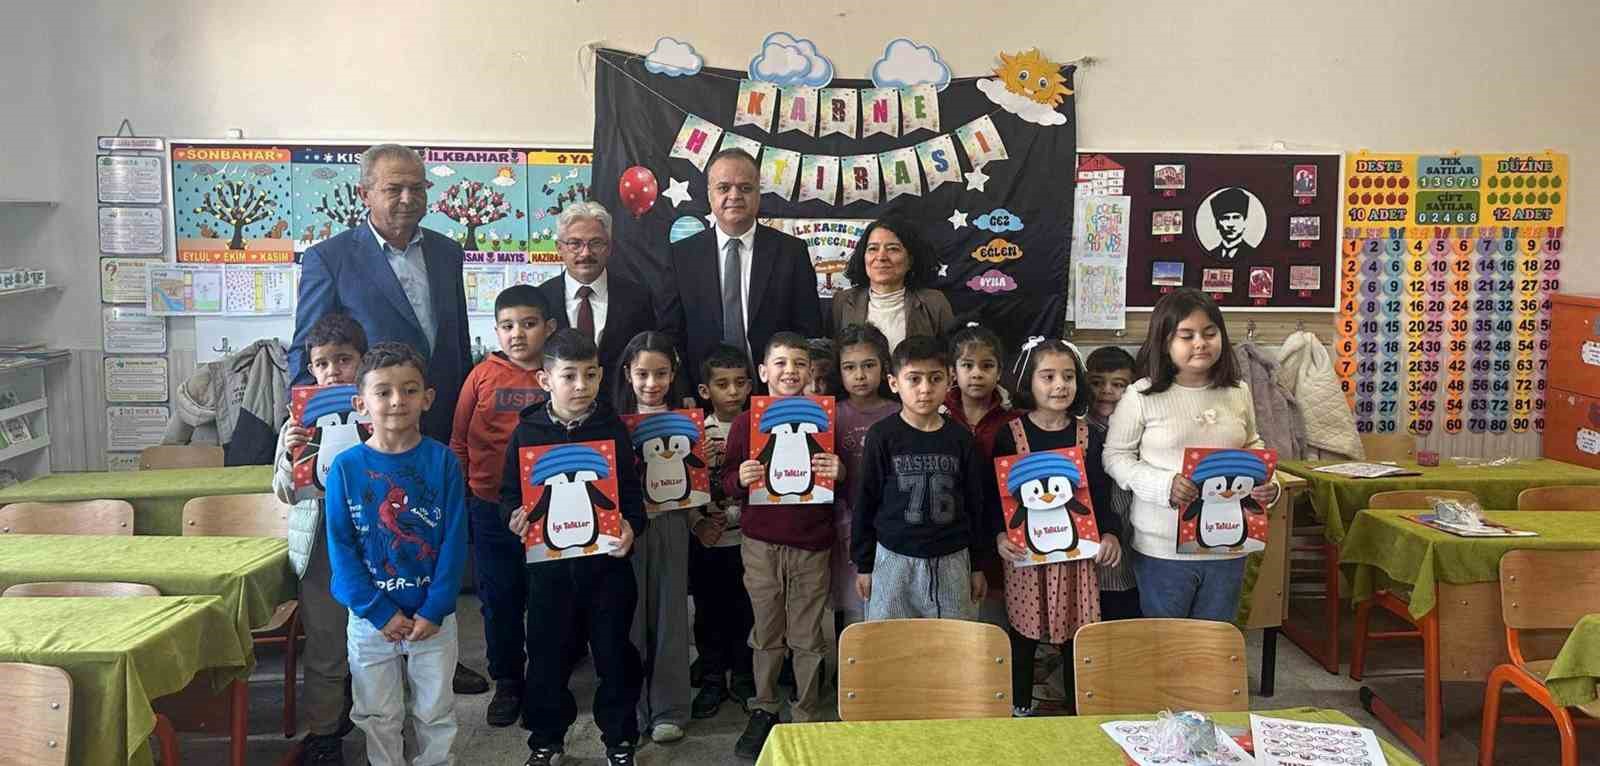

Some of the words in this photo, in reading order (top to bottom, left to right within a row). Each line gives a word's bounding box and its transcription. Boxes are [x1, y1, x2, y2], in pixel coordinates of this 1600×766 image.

[747, 91, 927, 123] KARNE
[186, 150, 277, 161] SONBAHAR
[428, 150, 509, 163] İLKBAHAR
[571, 153, 593, 165] YA
[685, 127, 991, 190] HTIRASI
[1357, 160, 1402, 173] DESTE
[1440, 158, 1461, 166] TEK
[1498, 156, 1553, 173] DÜZİNE
[1426, 166, 1474, 175] SAYILAR
[1421, 178, 1426, 187] 1
[1434, 178, 1440, 187] 3
[1446, 178, 1453, 187] 5
[1460, 178, 1466, 187] 7
[1472, 178, 1478, 187] 9
[1425, 203, 1473, 211] SAYILAR
[1349, 208, 1366, 221] 10
[1368, 208, 1407, 221] ADET
[1418, 213, 1426, 222] 0
[1432, 213, 1440, 222] 2
[1444, 213, 1450, 222] 4
[1457, 213, 1464, 222] 6
[1470, 213, 1476, 222] 8
[1493, 208, 1511, 221] 12
[1512, 208, 1553, 221] ADET
[792, 223, 811, 236] İLK
[807, 236, 856, 248] HEYECAN
[1350, 241, 1355, 252] 1
[1370, 241, 1378, 252] 2
[1393, 241, 1400, 252] 3
[1414, 241, 1423, 252] 4
[1437, 241, 1444, 252] 5
[1460, 240, 1467, 251] 6
[1483, 240, 1491, 251] 7
[1505, 240, 1512, 251] 8
[1528, 240, 1535, 251] 9
[1546, 240, 1560, 251] 10
[183, 250, 209, 262] EYLÜL
[224, 250, 246, 262] EKİM
[260, 250, 289, 262] KASIM
[496, 252, 525, 262] MAYIS
[1348, 261, 1355, 272] 2
[1369, 261, 1377, 272] 4
[1392, 261, 1399, 272] 6
[1414, 261, 1421, 272] 8
[1432, 261, 1446, 272] 10
[1456, 260, 1469, 271] 12
[1480, 260, 1494, 271] 14
[1500, 260, 1513, 271] 16
[1523, 260, 1537, 271] 18
[1544, 260, 1559, 271] 20
[1347, 281, 1354, 292] 3
[1368, 281, 1376, 292] 6
[1390, 281, 1398, 292] 9
[1410, 281, 1424, 292] 12
[1431, 281, 1444, 292] 15
[1455, 280, 1468, 291] 18
[1479, 280, 1493, 291] 21
[1499, 280, 1513, 291] 24
[1522, 280, 1537, 291] 27
[1543, 280, 1558, 291] 30
[1346, 301, 1353, 312] 4
[1368, 301, 1375, 312] 8
[1387, 301, 1400, 312] 12
[1410, 301, 1424, 312] 16
[1429, 301, 1444, 312] 20
[1453, 300, 1468, 311] 24
[1476, 300, 1493, 311] 28
[1498, 300, 1512, 311] 32
[1520, 300, 1536, 311] 36
[1345, 321, 1352, 332] 5
[1363, 321, 1377, 332] 10
[1386, 321, 1399, 332] 15
[1409, 321, 1424, 332] 20
[1428, 321, 1442, 332] 25
[1451, 320, 1467, 331] 30
[1476, 320, 1491, 331] 35
[1497, 320, 1511, 331] 40
[1519, 320, 1535, 331] 45
[1541, 320, 1552, 331] 5
[1344, 341, 1351, 352] 6
[1362, 341, 1376, 352] 12
[1385, 341, 1398, 352] 18
[1409, 341, 1424, 352] 24
[1426, 341, 1440, 352] 30
[1451, 340, 1466, 351] 36
[1475, 340, 1490, 351] 42
[1496, 340, 1510, 351] 48
[1519, 340, 1533, 351] 54
[1540, 340, 1551, 351] 6
[1342, 362, 1350, 372] 7
[1361, 362, 1375, 372] 14
[1384, 362, 1397, 372] 21
[1424, 362, 1439, 372] 35
[1449, 361, 1465, 371] 42
[1473, 361, 1489, 371] 49
[1494, 361, 1510, 371] 56
[1517, 361, 1532, 371] 63
[1539, 361, 1548, 371] 7
[1342, 381, 1349, 392] 8
[1360, 381, 1374, 392] 16
[1382, 381, 1397, 392] 24
[1422, 381, 1437, 392] 40
[1448, 380, 1463, 391] 48
[1472, 380, 1488, 391] 56
[1493, 380, 1508, 391] 64
[1516, 380, 1531, 391] 72
[1538, 380, 1546, 391] 8
[1359, 401, 1372, 411] 18
[1380, 401, 1396, 411] 27
[1420, 401, 1435, 411] 45
[1447, 400, 1463, 410] 54
[1471, 400, 1486, 410] 63
[1491, 400, 1508, 410] 72
[1515, 400, 1530, 410] 81
[1536, 400, 1545, 410] 9
[1357, 421, 1373, 431] 20
[1379, 421, 1394, 431] 30
[1418, 421, 1432, 431] 50
[1447, 420, 1461, 430] 60
[1470, 420, 1486, 430] 70
[1491, 420, 1507, 430] 80
[1514, 420, 1528, 430] 90
[893, 455, 960, 473] FASHION
[896, 473, 954, 524] 76
